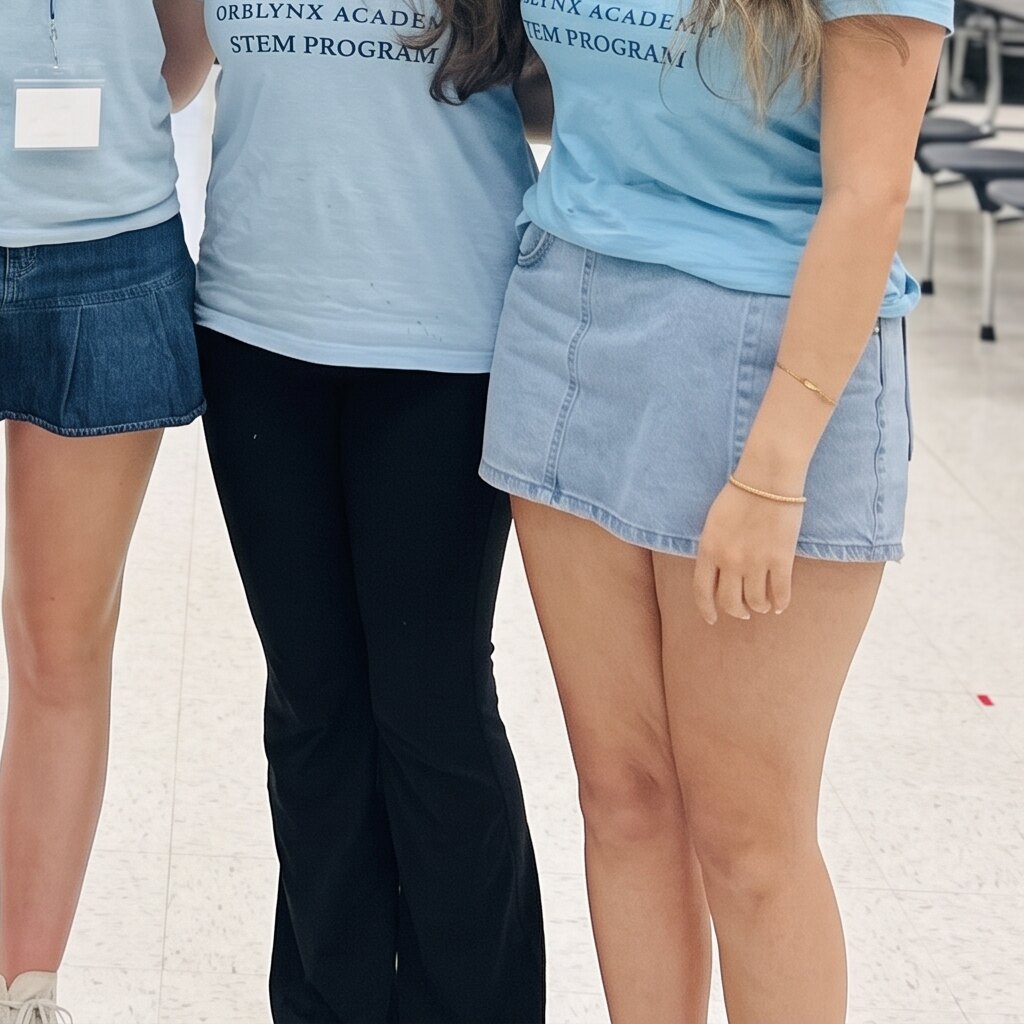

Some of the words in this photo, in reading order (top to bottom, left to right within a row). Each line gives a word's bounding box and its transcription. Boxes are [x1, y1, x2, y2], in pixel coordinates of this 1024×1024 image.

[216, 2, 324, 22] ORBLYNX
[332, 6, 441, 30] ACADE
[229, 34, 296, 54] STEM
[303, 35, 440, 65] PROGRAM
[523, 19, 563, 45] TEM
[564, 27, 688, 69] PROGRAM
